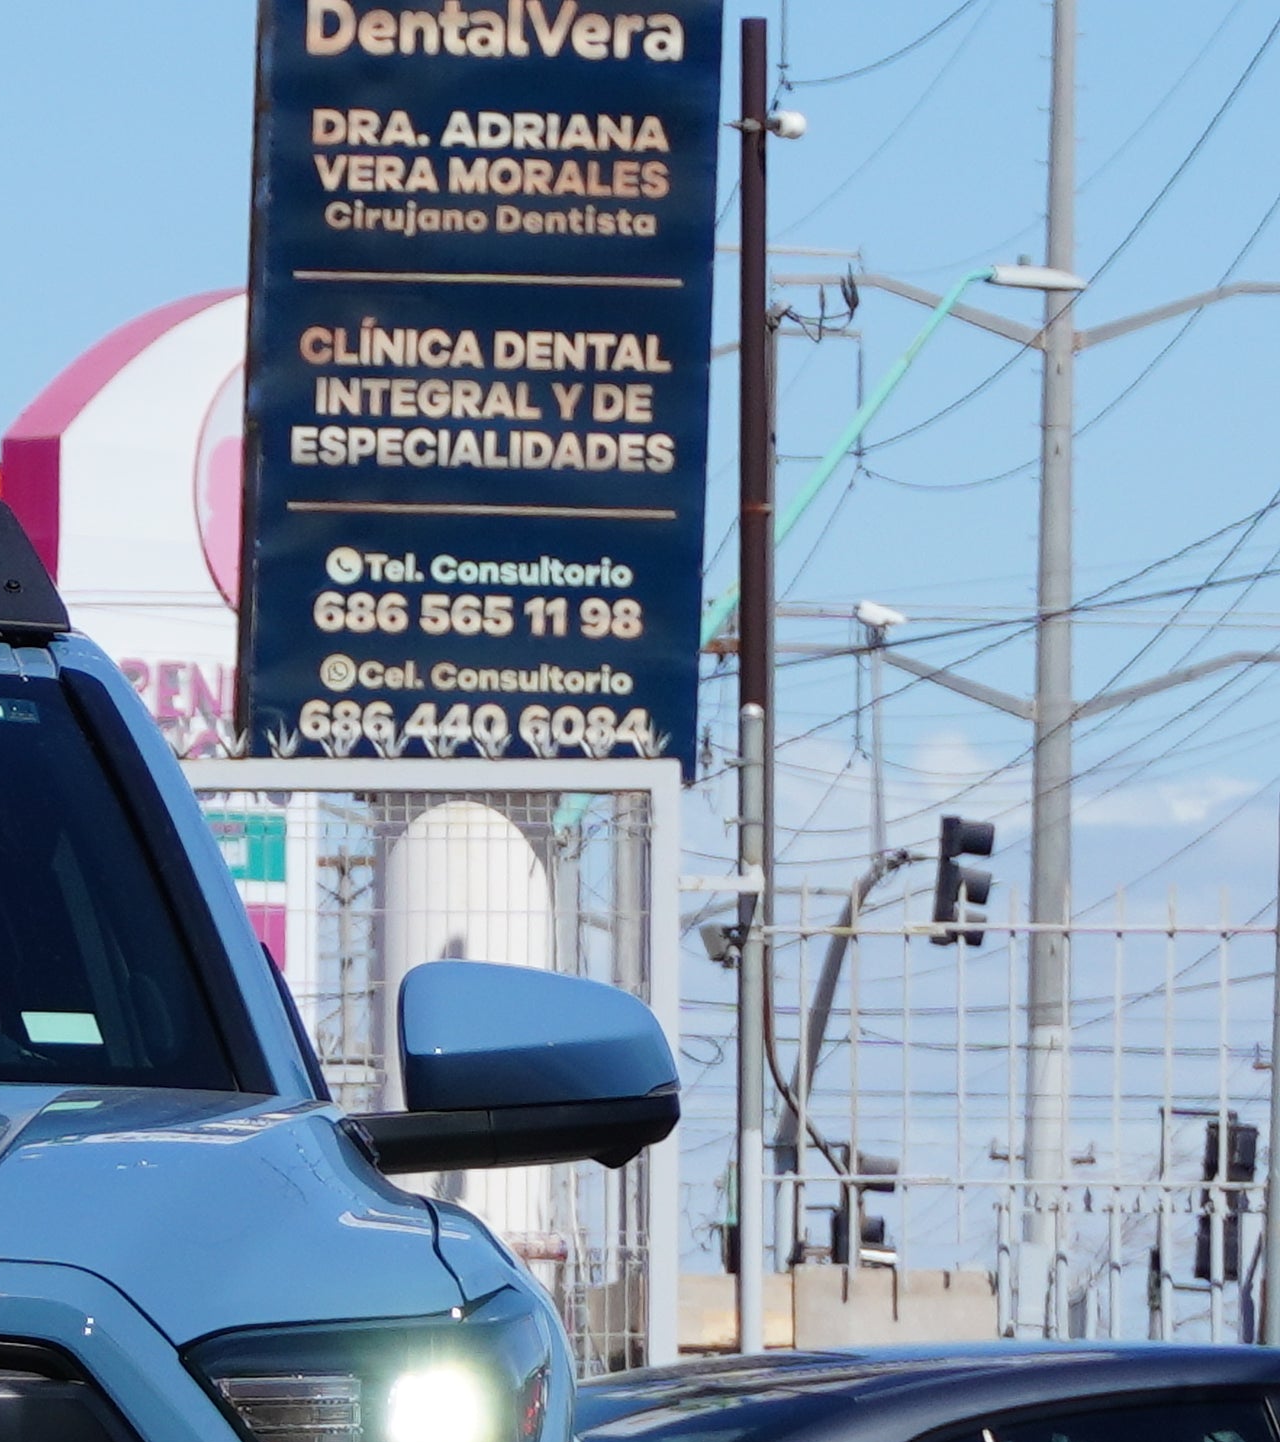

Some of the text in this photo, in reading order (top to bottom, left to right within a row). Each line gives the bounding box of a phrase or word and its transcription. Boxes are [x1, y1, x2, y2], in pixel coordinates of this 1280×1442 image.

[304, 0, 685, 62] DentalVera
[311, 108, 671, 153] DRA. ADRIANA
[313, 154, 671, 199] VERA MORALES
[324, 200, 657, 237] Cirujano Dentista
[299, 316, 673, 373] CLÍNICA DENTAL
[315, 375, 654, 423] INTEGRAL Y DE
[290, 425, 676, 473] ESPECIALIDADES
[364, 552, 634, 588] Tel. Consultorio
[313, 591, 643, 639] 686 565 11 98
[358, 660, 634, 696] Cel. Consultorio
[299, 699, 649, 747] 686 440 6084
